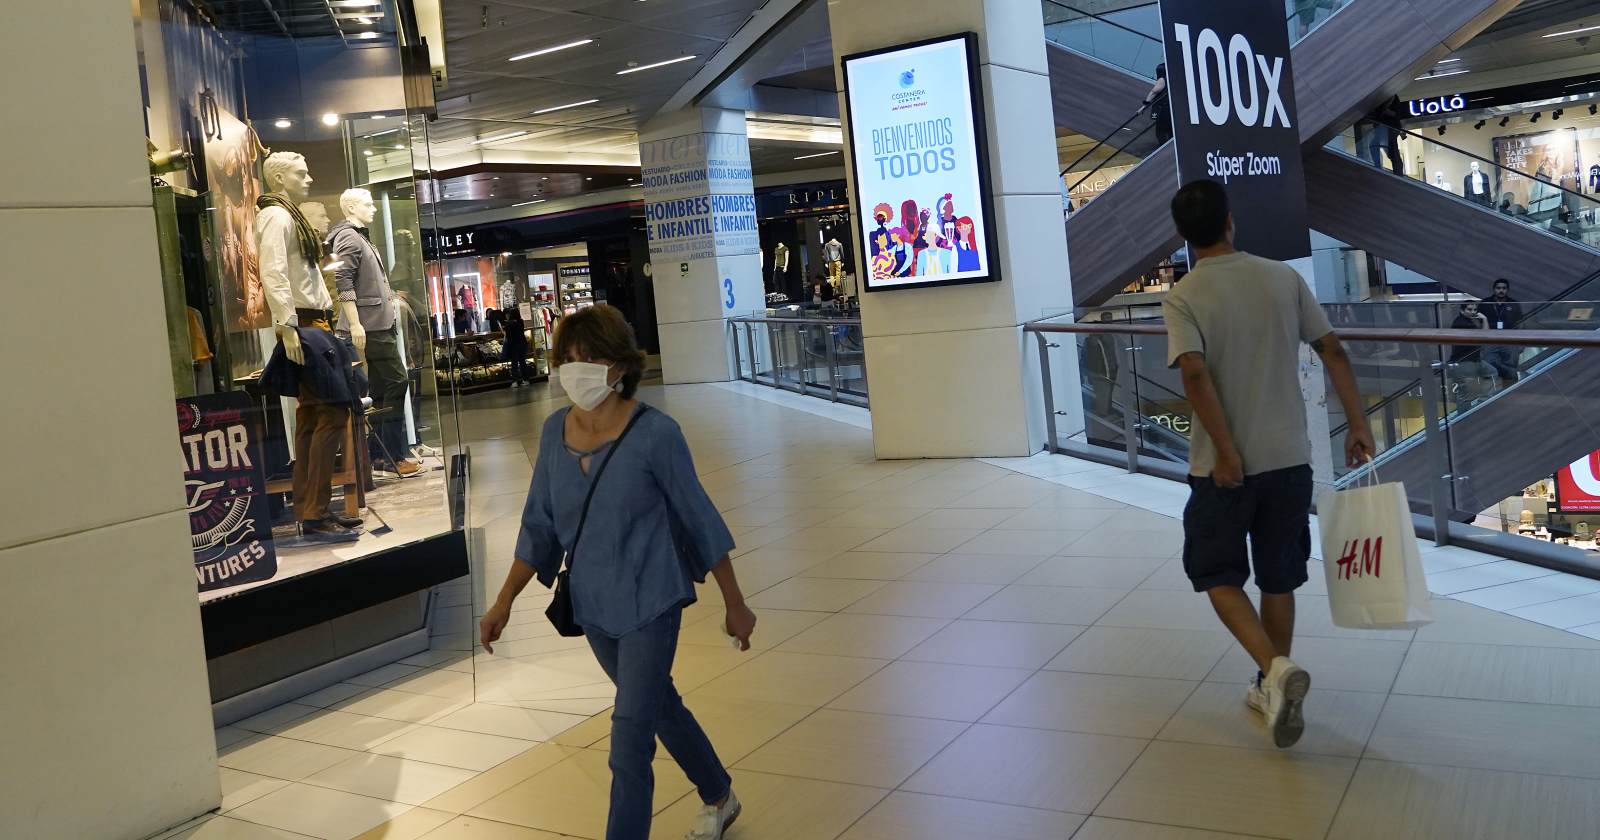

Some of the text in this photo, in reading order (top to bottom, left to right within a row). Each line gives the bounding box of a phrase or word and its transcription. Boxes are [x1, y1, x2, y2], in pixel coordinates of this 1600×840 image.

[1174, 23, 1291, 128] 100x
[872, 117, 953, 156] BIENVENIDOS
[708, 167, 752, 179] MODA FASHION
[874, 147, 956, 180] TODOS
[1206, 149, 1281, 185] Súper Zoom
[642, 174, 669, 188] MODA
[669, 169, 707, 185] FASHION
[646, 196, 711, 222] HOMBRES
[711, 195, 756, 213] HOMBRES
[647, 217, 713, 241] E INFANTIL
[713, 215, 758, 233] E INFANTIL
[724, 278, 735, 309] 3
[1336, 536, 1382, 580] H&M
